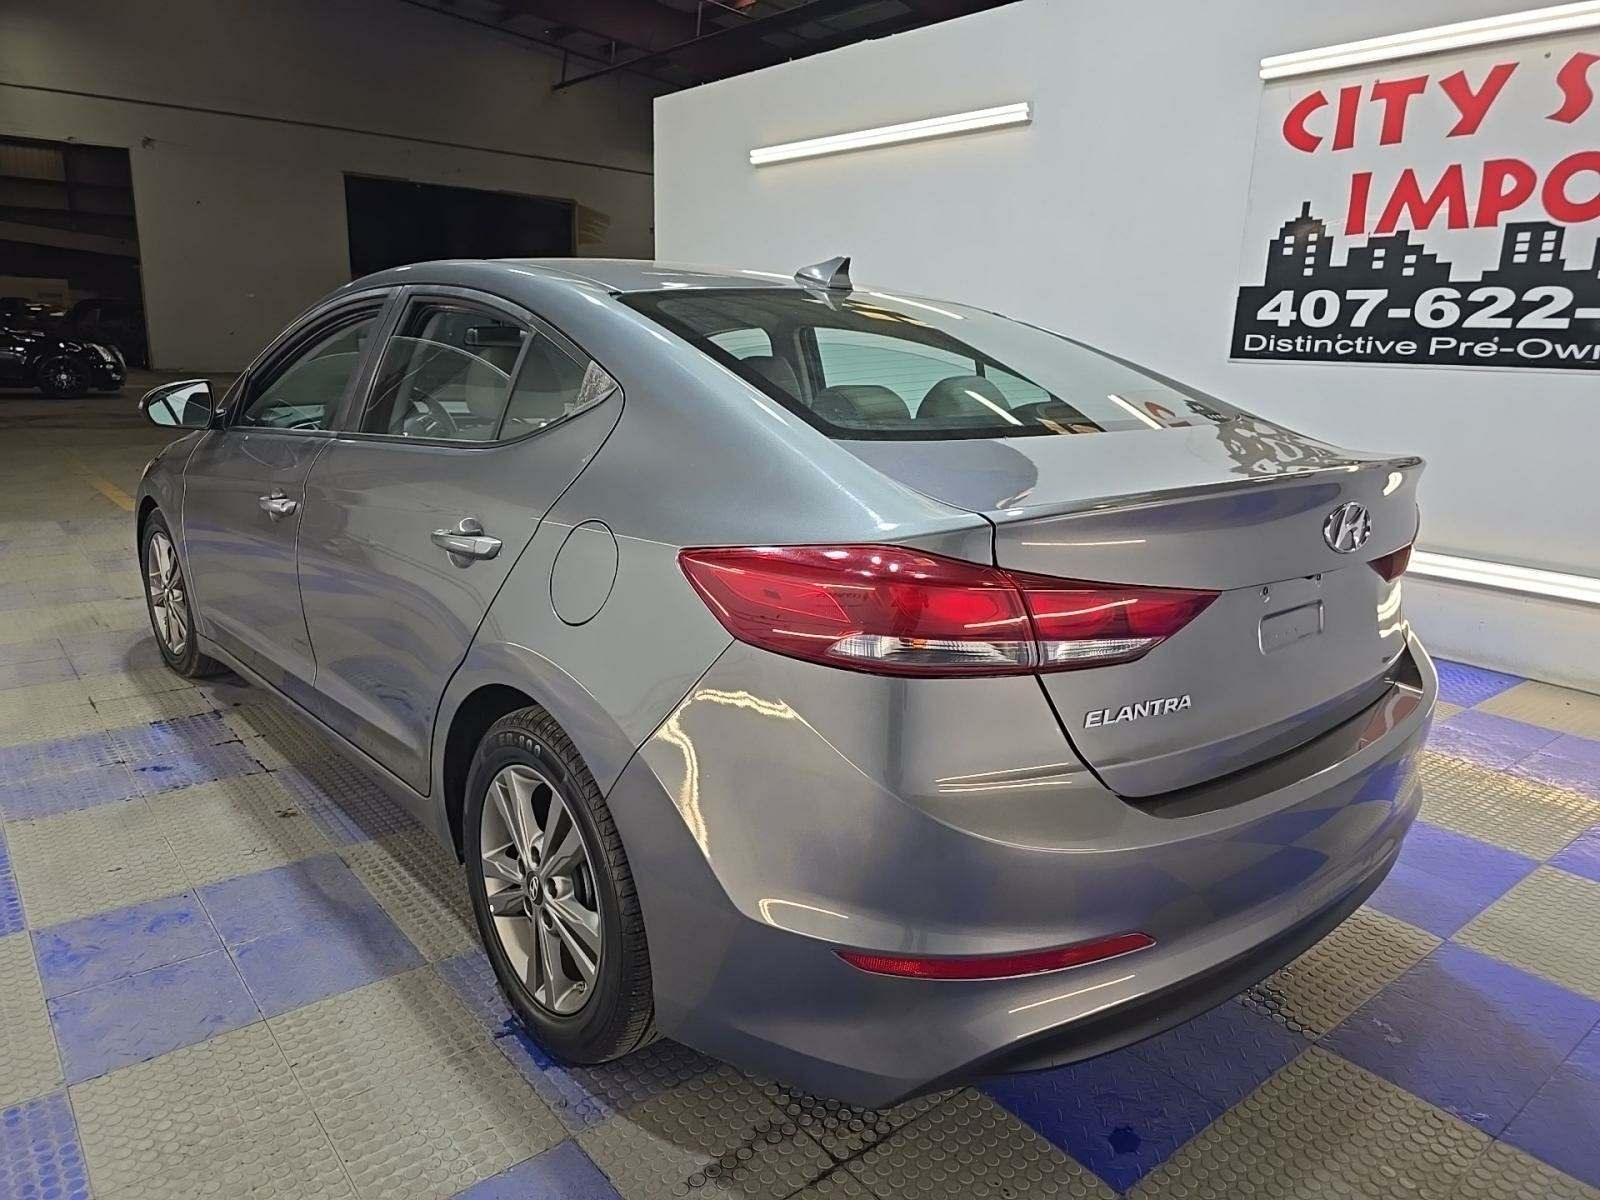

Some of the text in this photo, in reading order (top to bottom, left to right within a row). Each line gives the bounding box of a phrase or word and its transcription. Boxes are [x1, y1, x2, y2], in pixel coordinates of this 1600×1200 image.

[1282, 51, 1600, 153] CITY S
[1344, 151, 1600, 236] IMPO
[1256, 286, 1600, 330] 407-622-
[1244, 334, 1418, 356] Distinctive
[1083, 694, 1192, 729] ELANTRA
